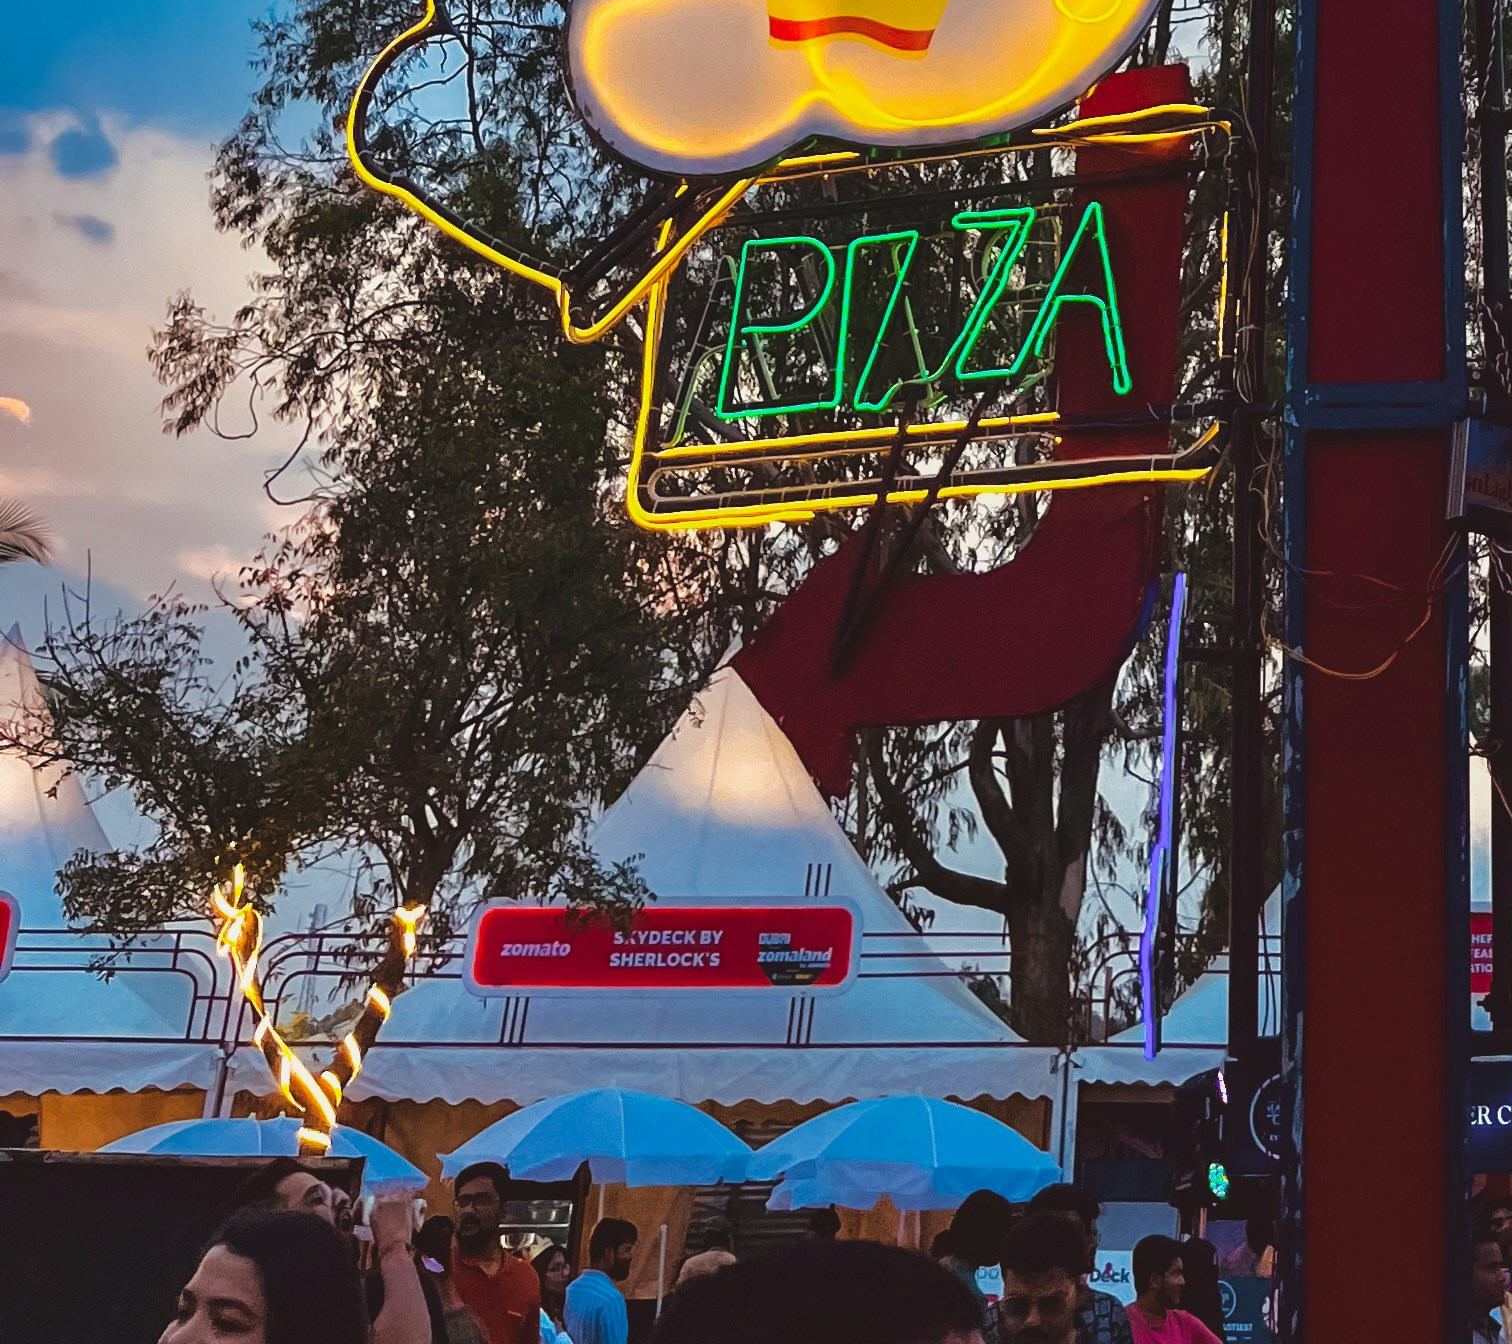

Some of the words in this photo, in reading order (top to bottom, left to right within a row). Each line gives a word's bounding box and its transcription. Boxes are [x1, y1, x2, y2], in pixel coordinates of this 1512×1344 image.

[715, 200, 1132, 420] PIZZA
[700, 930, 724, 945] BY
[500, 940, 572, 957] zomato
[757, 947, 833, 963] zomaland
[609, 952, 721, 967] SHERLOCK'S
